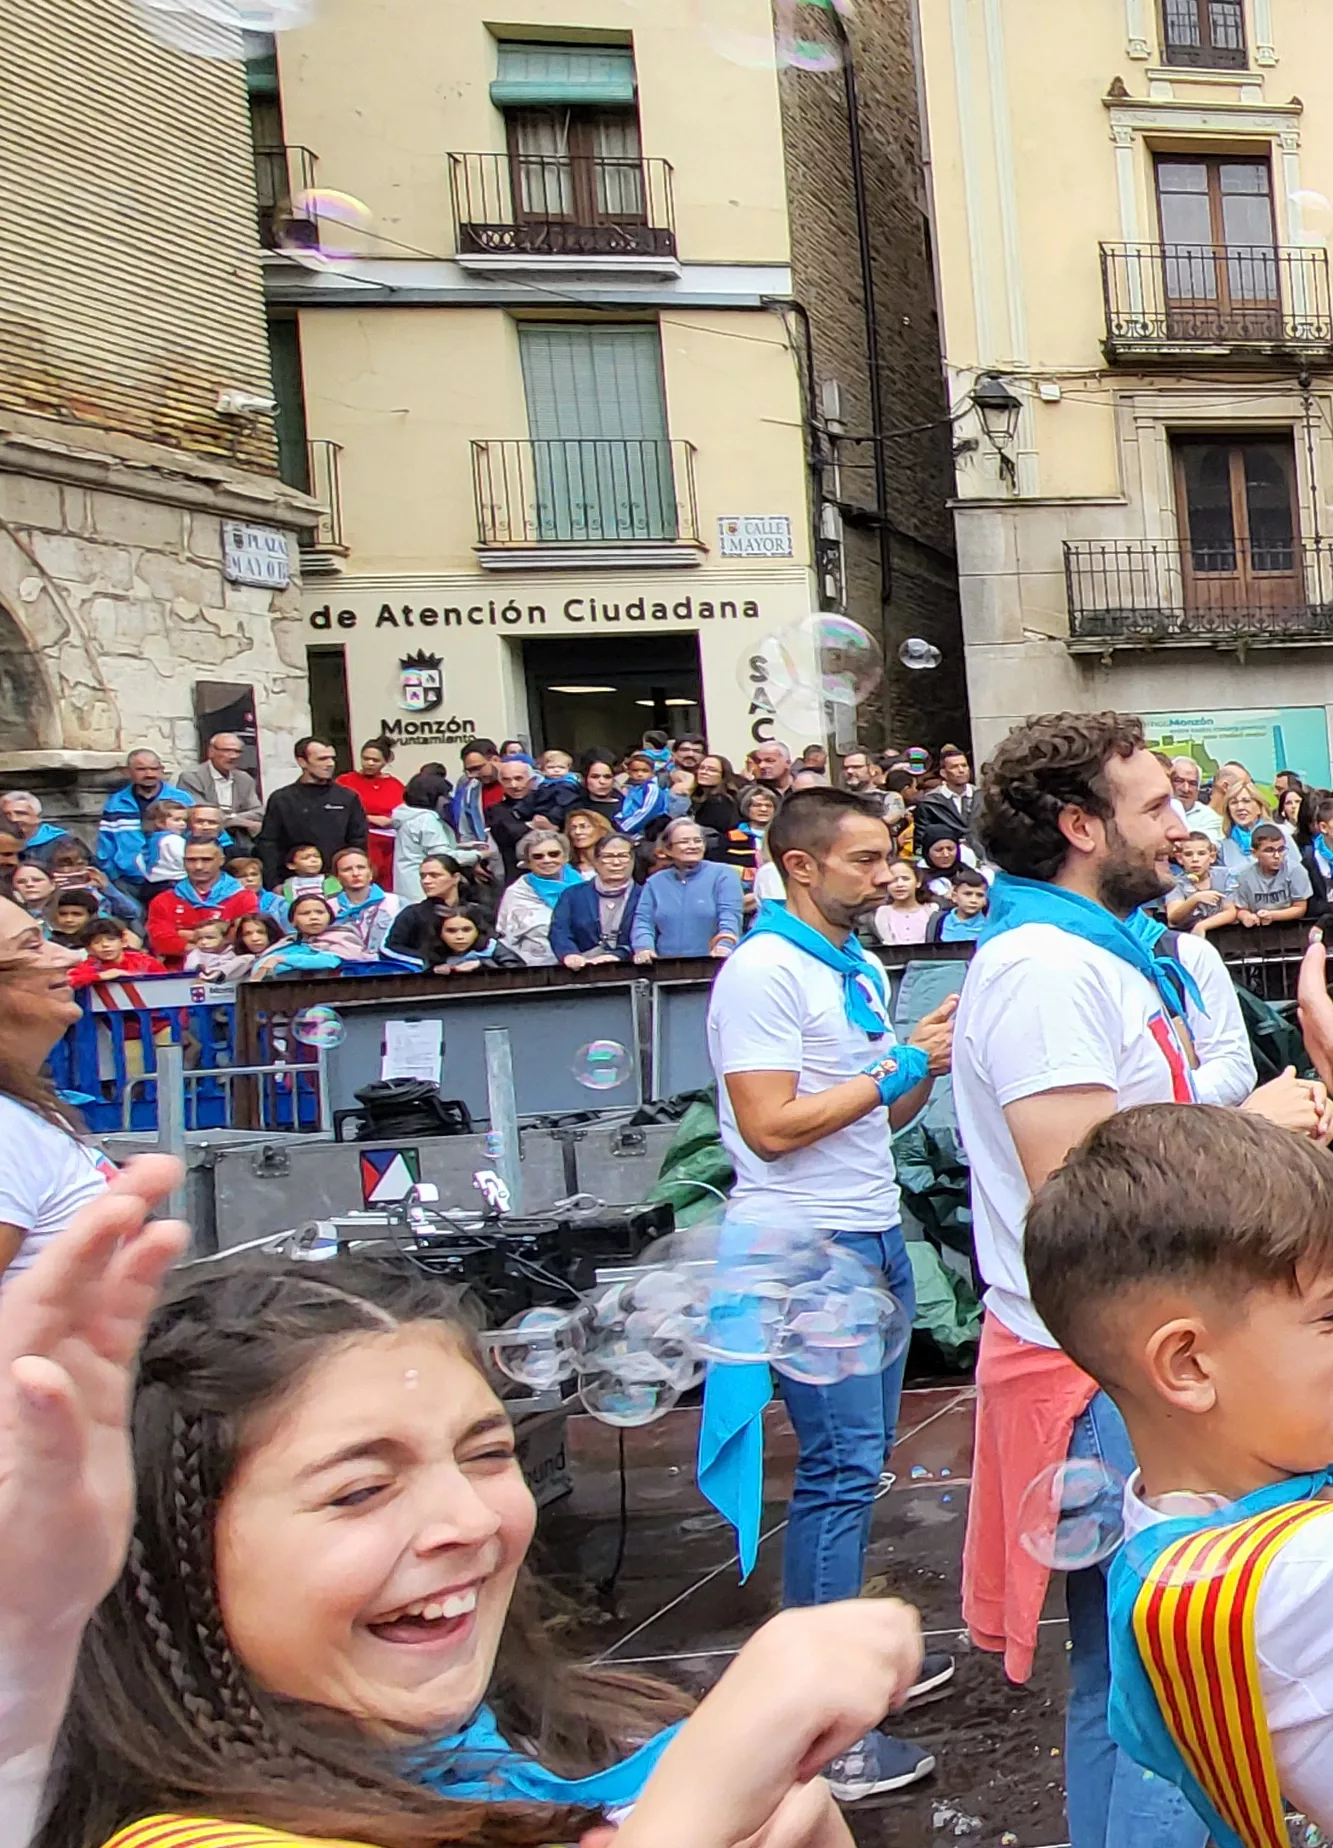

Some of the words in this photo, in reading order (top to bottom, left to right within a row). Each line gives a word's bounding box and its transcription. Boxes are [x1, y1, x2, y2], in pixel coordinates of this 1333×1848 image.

[745, 522, 784, 535] CALLE
[729, 537, 785, 552] MAYOR
[309, 604, 357, 629] de
[375, 599, 546, 628] Atención
[563, 595, 760, 622] Ciudadana
[748, 655, 776, 743] SAC
[381, 715, 476, 735] Monzón
[393, 733, 477, 746] yuntamiento
